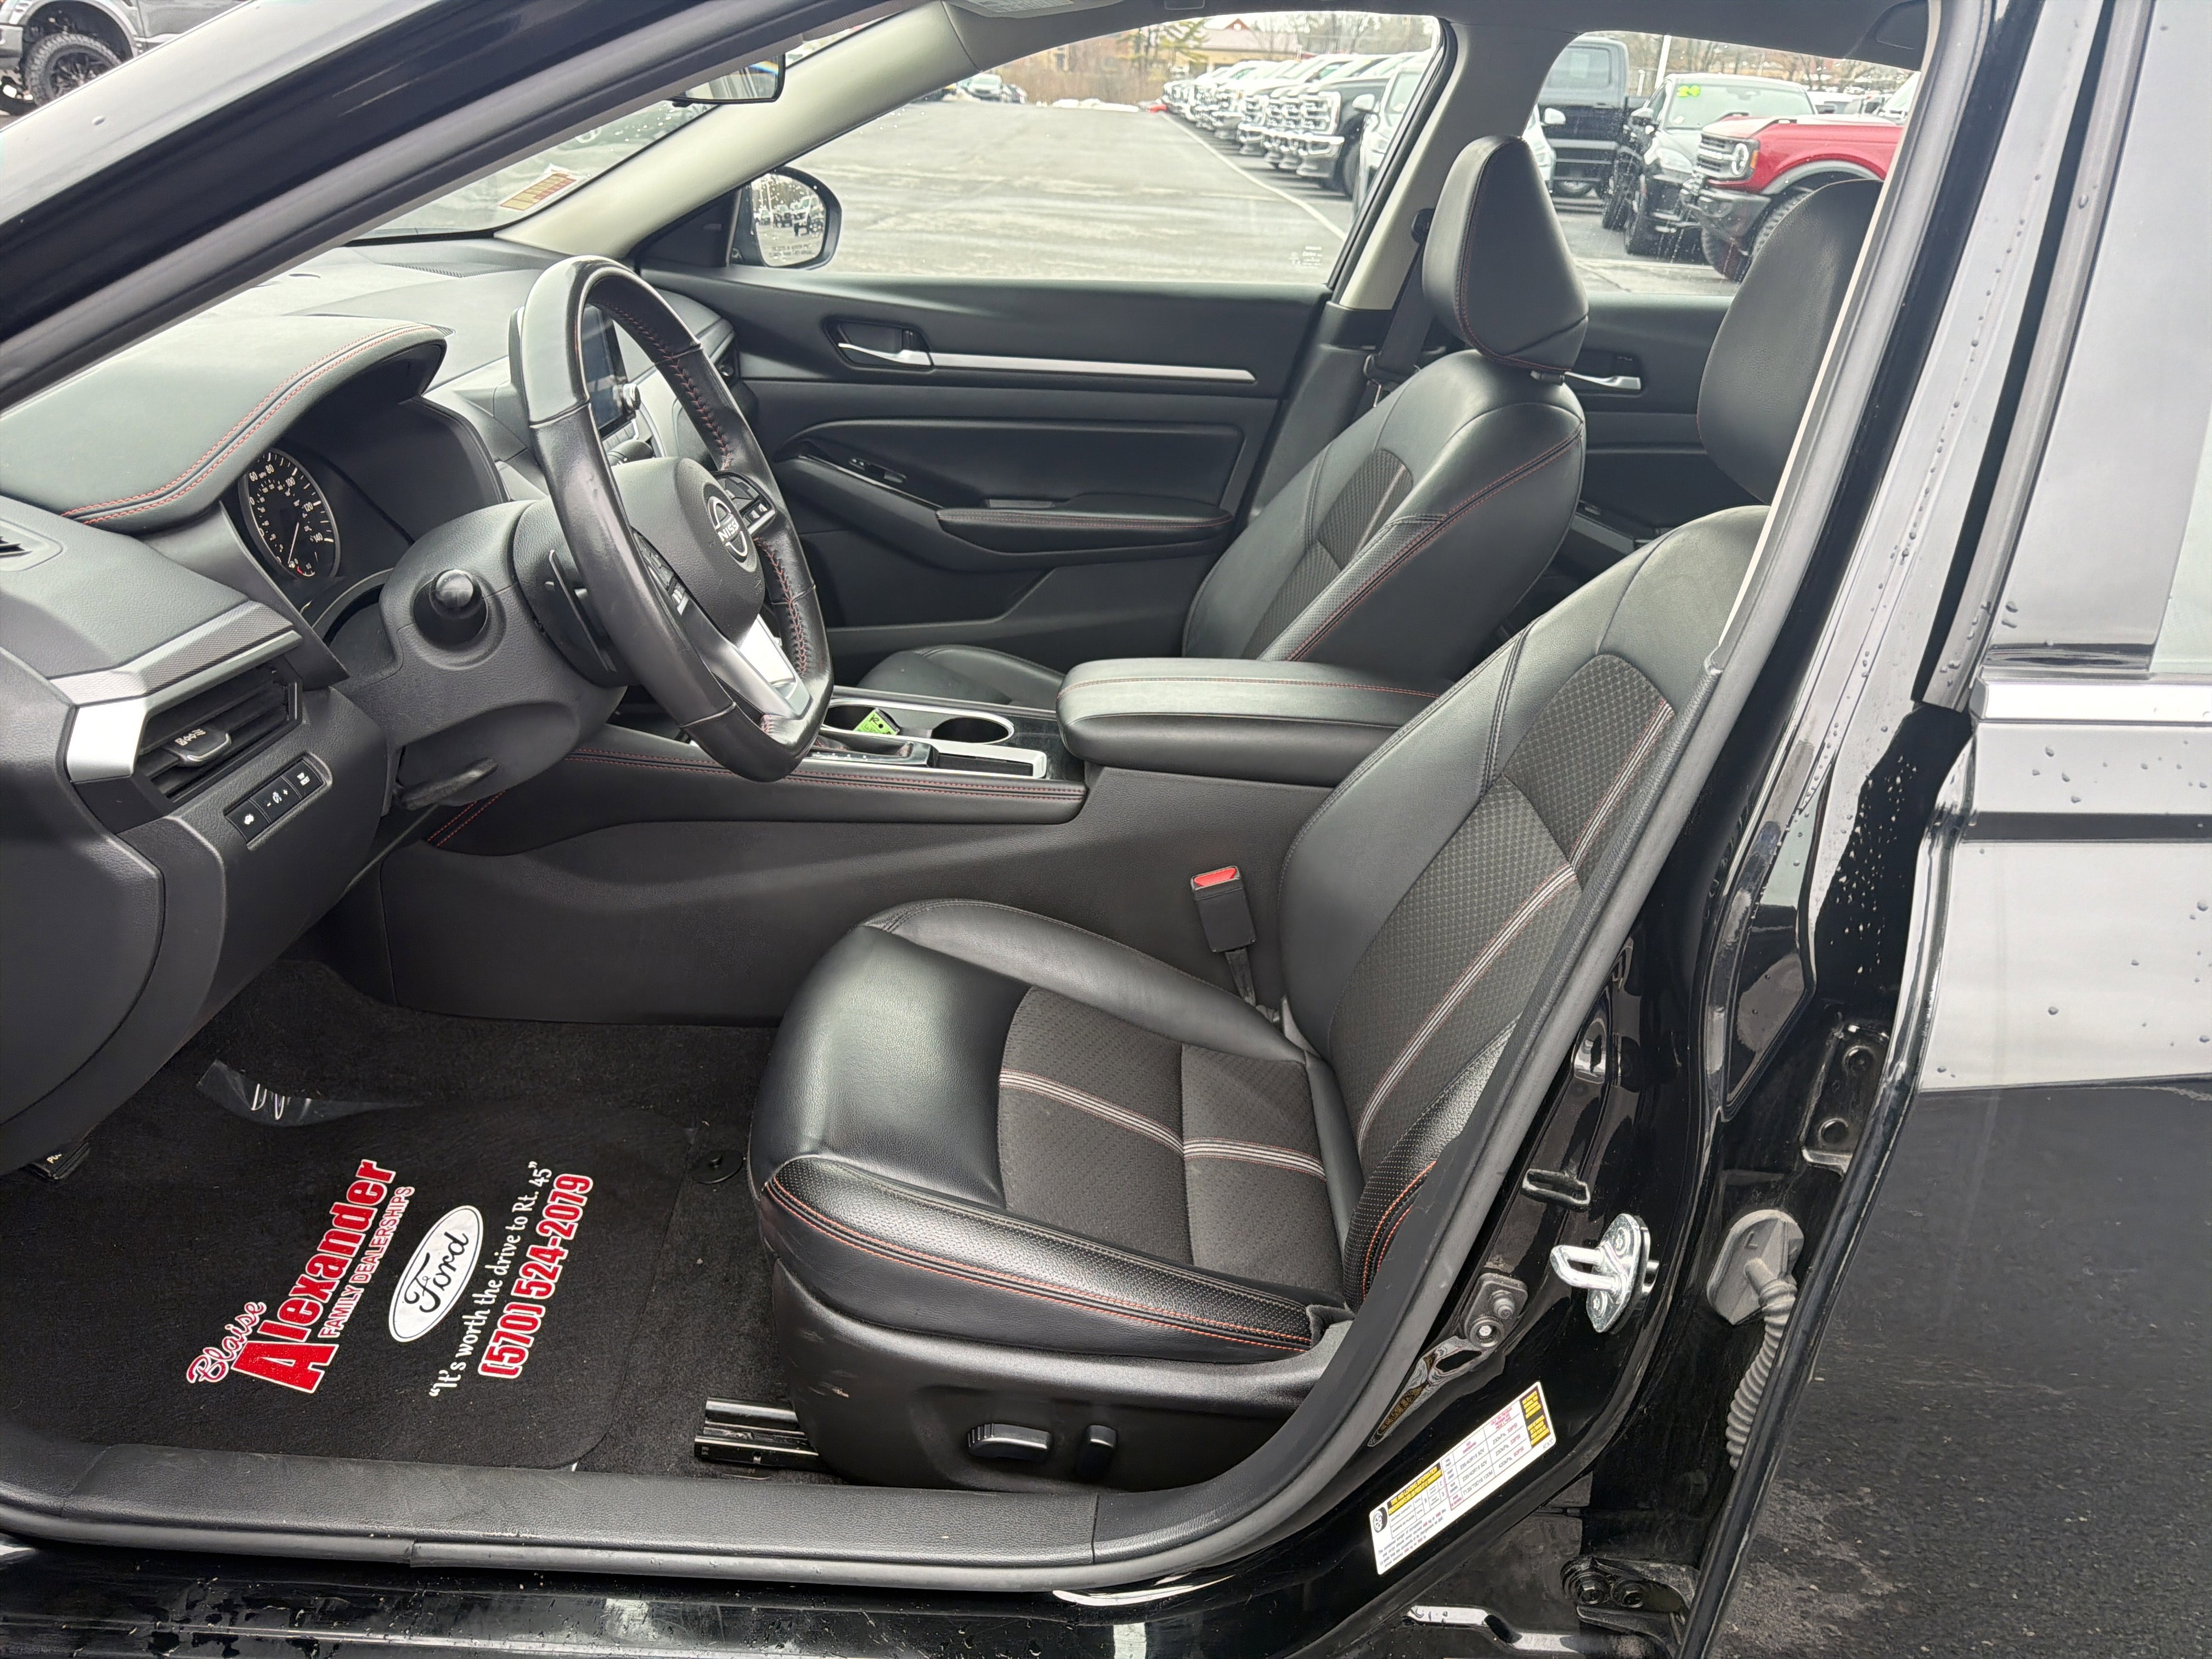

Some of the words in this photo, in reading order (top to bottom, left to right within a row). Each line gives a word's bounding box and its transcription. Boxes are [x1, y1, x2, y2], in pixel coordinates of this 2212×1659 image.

[249, 471, 258, 482] 60
[266, 464, 274, 474] 80
[285, 476, 296, 487] 100
[303, 501, 313, 512] 120
[313, 532, 323, 543] 140
[511, 1190, 539, 1213] Rt.
[505, 1216, 528, 1231] to
[510, 1173, 594, 1300] 524-2079
[318, 1285, 364, 1338] FAMILY
[349, 1187, 415, 1283] DEALERSHIPS
[484, 1234, 521, 1276] drive
[230, 1159, 396, 1393] Alexander
[404, 1231, 469, 1313] Ford
[472, 1279, 503, 1305] the
[187, 1302, 267, 1384] Blaise
[455, 1309, 490, 1358] worth
